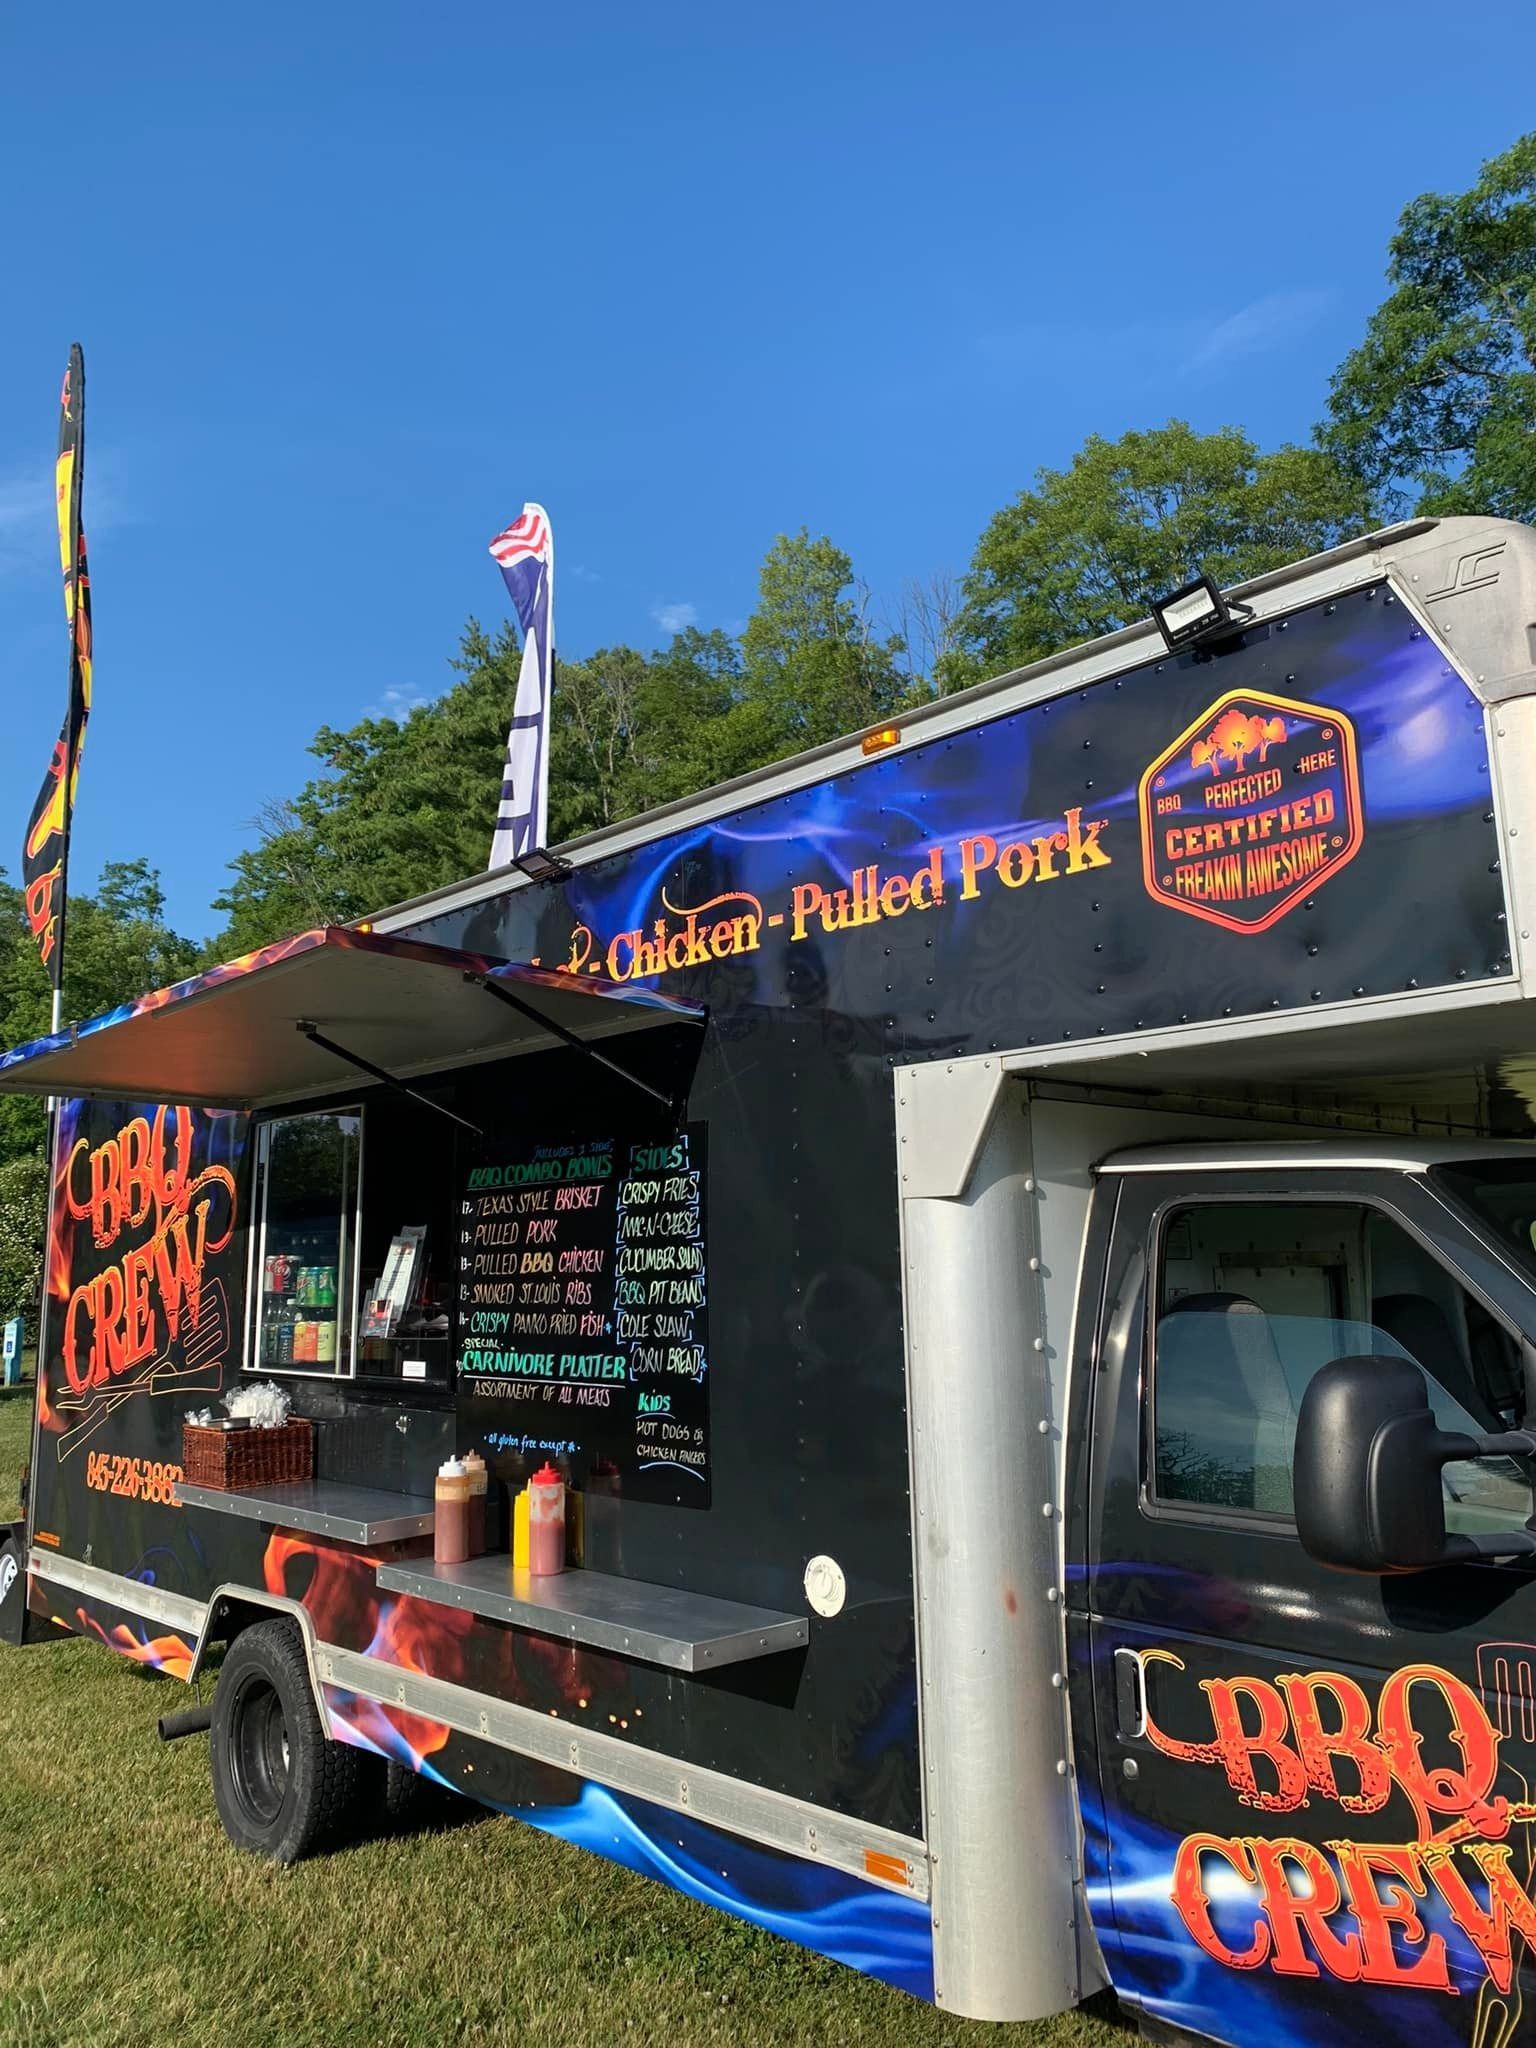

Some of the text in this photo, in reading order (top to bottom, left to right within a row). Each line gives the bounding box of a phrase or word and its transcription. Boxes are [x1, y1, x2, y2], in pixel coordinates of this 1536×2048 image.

[1156, 748, 1338, 815] BBQ PERFECTED HERE
[1165, 787, 1336, 861] CERTIFIED
[1174, 831, 1330, 901] FREAKIN AWESOME
[605, 889, 763, 983] Chicken
[789, 845, 947, 942] Pulled
[958, 806, 1112, 901] Pork
[467, 1154, 614, 1188] BBQ COMBO BOWLS
[634, 1141, 683, 1172] SIDES
[67, 1104, 195, 1248] BBQ
[622, 1175, 697, 1204] CRISPY FRIES
[476, 1194, 514, 1217] TEXAS
[516, 1189, 552, 1214] STYLE
[554, 1183, 605, 1211] BRISKET
[474, 1221, 519, 1246] PULLED
[526, 1219, 559, 1245] PORK
[473, 1252, 518, 1275] PULLED
[519, 1251, 554, 1274] BBQ
[558, 1245, 605, 1273] CHICKEN
[619, 1246, 704, 1276] CUCUMBER SALAD
[62, 1199, 211, 1397] CREW
[470, 1281, 515, 1305] SMOKED
[565, 1279, 593, 1306] RIBS
[618, 1279, 703, 1305] BBQ PIT BEANS
[470, 1311, 511, 1334] CRISPY
[512, 1312, 548, 1335] PANKO
[549, 1309, 577, 1336] FRIED
[620, 1313, 690, 1338] COLE SLAW
[463, 1347, 555, 1377] CARNIVORE
[558, 1352, 627, 1380] PLATTER
[631, 1346, 701, 1376] CORN BREAD
[472, 1380, 611, 1408] ASSORTMENT OF ALL MEATS
[498, 1434, 519, 1452] gluten
[520, 1435, 537, 1454] free
[539, 1439, 566, 1458] except
[636, 1421, 659, 1437] HOT
[661, 1423, 690, 1441] DOGS
[636, 1444, 678, 1461] CHICKEN
[1148, 1653, 1505, 1828] BBQ
[1170, 1832, 1536, 1996] CREW
